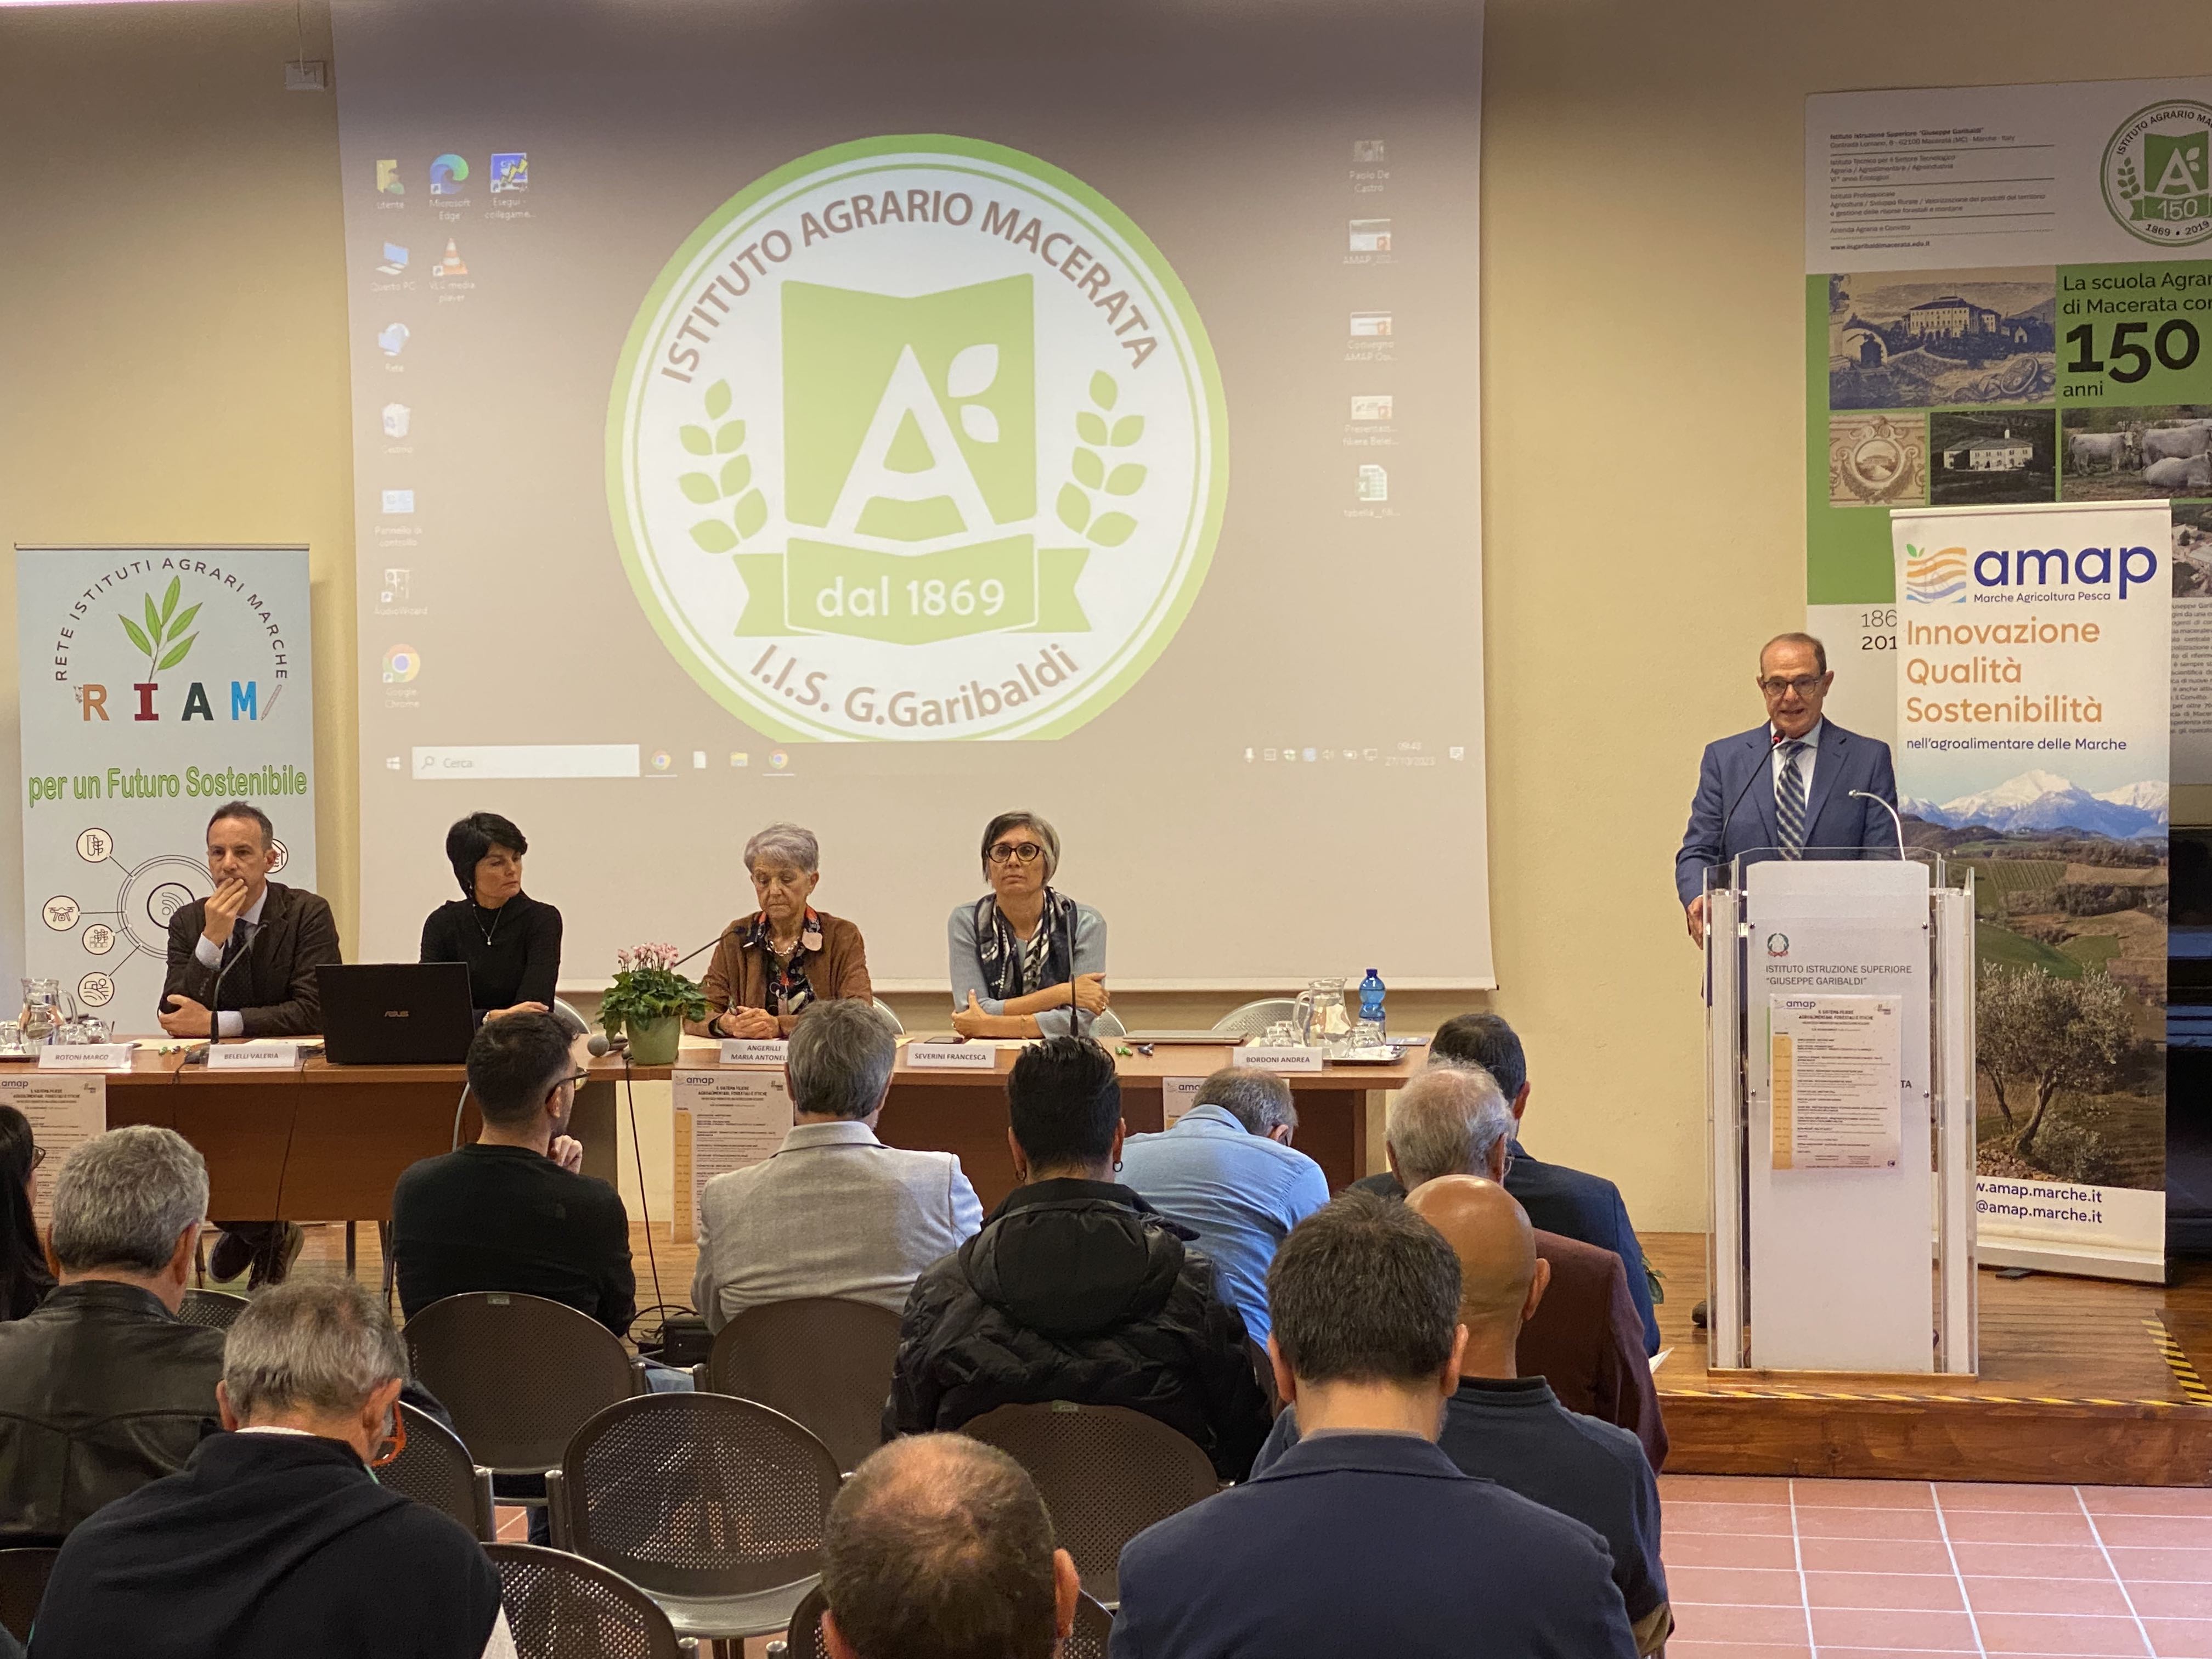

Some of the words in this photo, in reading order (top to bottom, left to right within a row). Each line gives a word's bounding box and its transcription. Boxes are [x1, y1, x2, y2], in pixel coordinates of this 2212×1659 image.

[2116, 121, 2148, 155] ISTITUTO
[2150, 109, 2194, 125] AGRARIO
[429, 199, 471, 208] Microsoft
[2158, 198, 2198, 220] 150
[439, 211, 460, 222] Edge
[2145, 223, 2171, 237] 1869
[2185, 220, 2210, 235] 2019
[661, 228, 793, 384] ISTITUTO
[800, 189, 974, 247] AGRARIO
[980, 200, 1159, 370] MACERATA
[2063, 275, 2086, 291] La
[2092, 272, 2156, 290] scuola
[2062, 299, 2080, 315] di
[2086, 297, 2178, 314] Macerata
[2066, 319, 2200, 383] 150
[2062, 381, 2104, 398] anni
[1973, 545, 2158, 600] amap
[816, 575, 889, 617] dal
[906, 578, 1005, 616] 1869
[1973, 594, 2014, 603] Marche
[2017, 591, 2075, 603] Agricoltura
[2078, 591, 2111, 601] Pesca
[55, 626, 74, 681] RETE
[69, 559, 151, 620] ISTITUTI
[162, 557, 245, 593] AGRARI
[247, 594, 288, 680] MARCHE
[1907, 616, 2101, 646] Innovazione
[1906, 656, 2022, 686] Qualità
[750, 644, 830, 713] I.I.S.
[844, 643, 1079, 727] G.Garibaldi
[1906, 695, 2103, 723] Sostenibilità
[2037, 738, 2072, 750] delle
[2075, 738, 2127, 751] Marche
[443, 757, 473, 769] Cerca
[29, 775, 67, 808] per
[73, 775, 100, 799] un
[107, 767, 180, 798] Futuro
[185, 764, 307, 797] Sostenibile
[1765, 965, 1804, 973] ISTITUTO
[1806, 965, 1858, 973] ISTRUZIONE
[1860, 965, 1912, 974] SUPERIORE
[1786, 1000, 1816, 1009] amap
[1, 1080, 29, 1089] amap
[686, 1076, 714, 1086] amap
